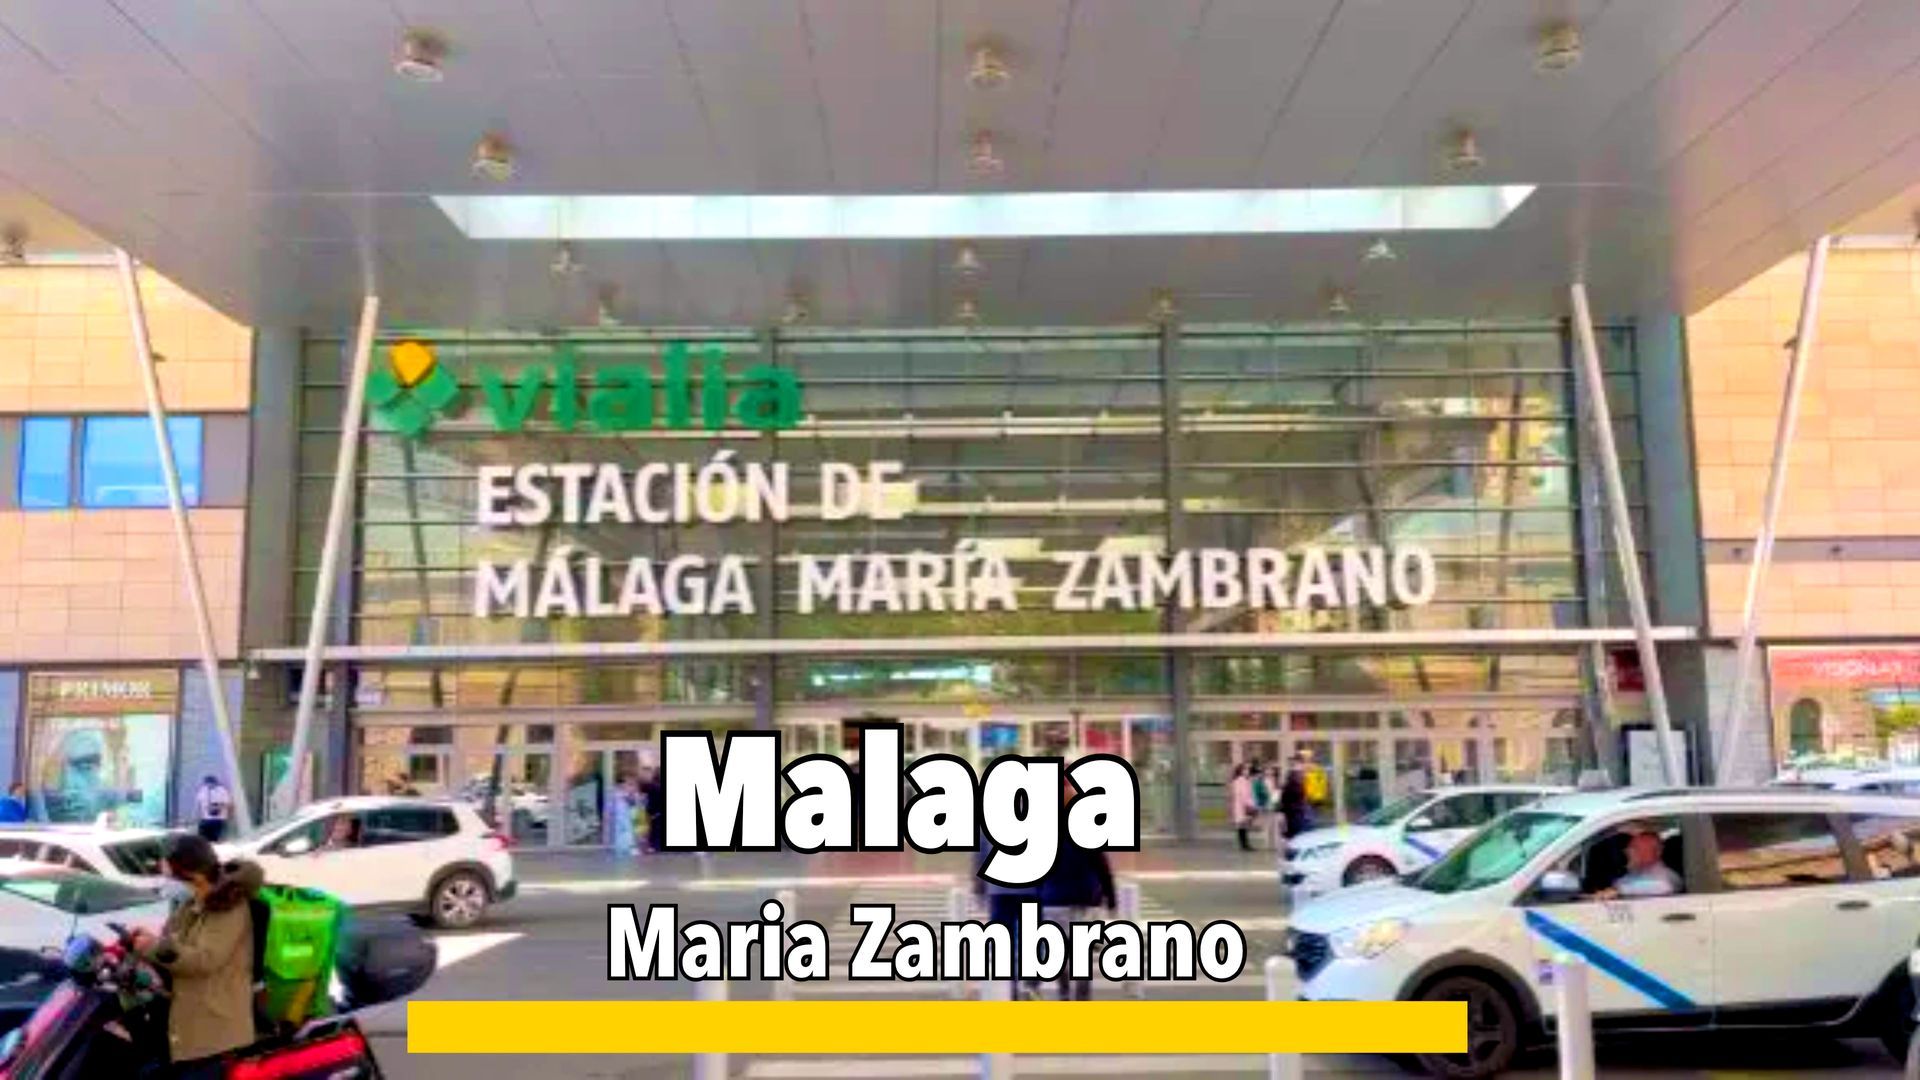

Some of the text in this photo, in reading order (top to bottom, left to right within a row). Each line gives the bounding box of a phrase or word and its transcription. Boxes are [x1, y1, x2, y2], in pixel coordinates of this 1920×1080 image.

[479, 341, 804, 432] vialia
[476, 450, 905, 526] ESTACIÓN DE
[474, 540, 1437, 617] MÁLAGA MARÍA ZAMBRANO
